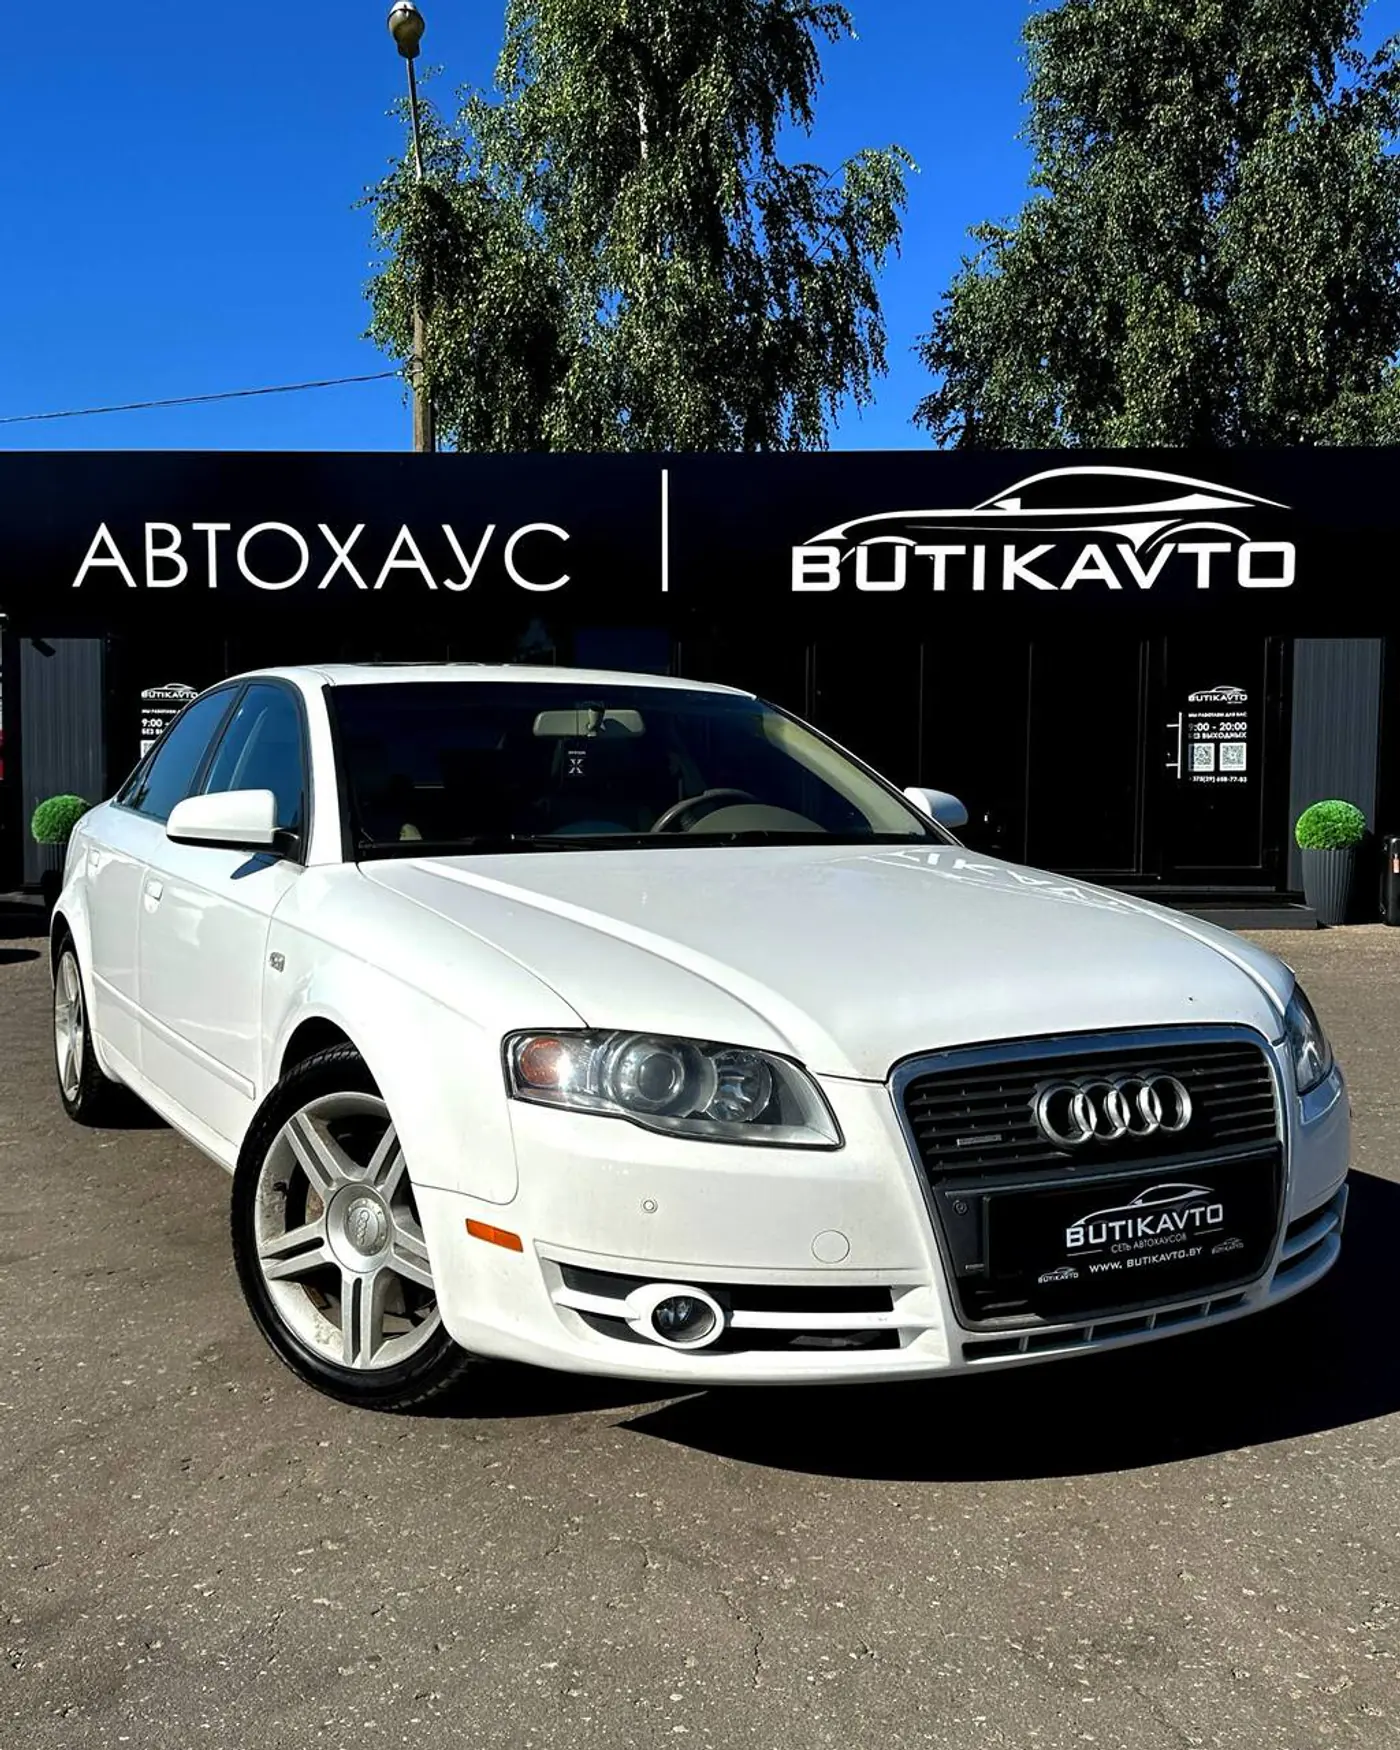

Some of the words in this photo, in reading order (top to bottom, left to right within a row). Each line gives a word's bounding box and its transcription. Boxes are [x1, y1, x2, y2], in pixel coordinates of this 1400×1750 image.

[72, 521, 571, 592] АВТОХАУС
[791, 541, 1296, 592] BUTIKAVTO
[1188, 694, 1248, 702] BUTIKAVTO
[141, 718, 163, 728] 9:00
[1219, 722, 1248, 731] 20:00
[1066, 1203, 1224, 1248] BUTIKAVTO
[1111, 1243, 1132, 1254] СЕТЬ
[1133, 1232, 1187, 1250] АВТОХАУСОВ
[1089, 1260, 1123, 1273] WWW.
[1126, 1247, 1203, 1268] BUTIKAVTO.BY
[1038, 1272, 1079, 1284] BUTIKAVTO
